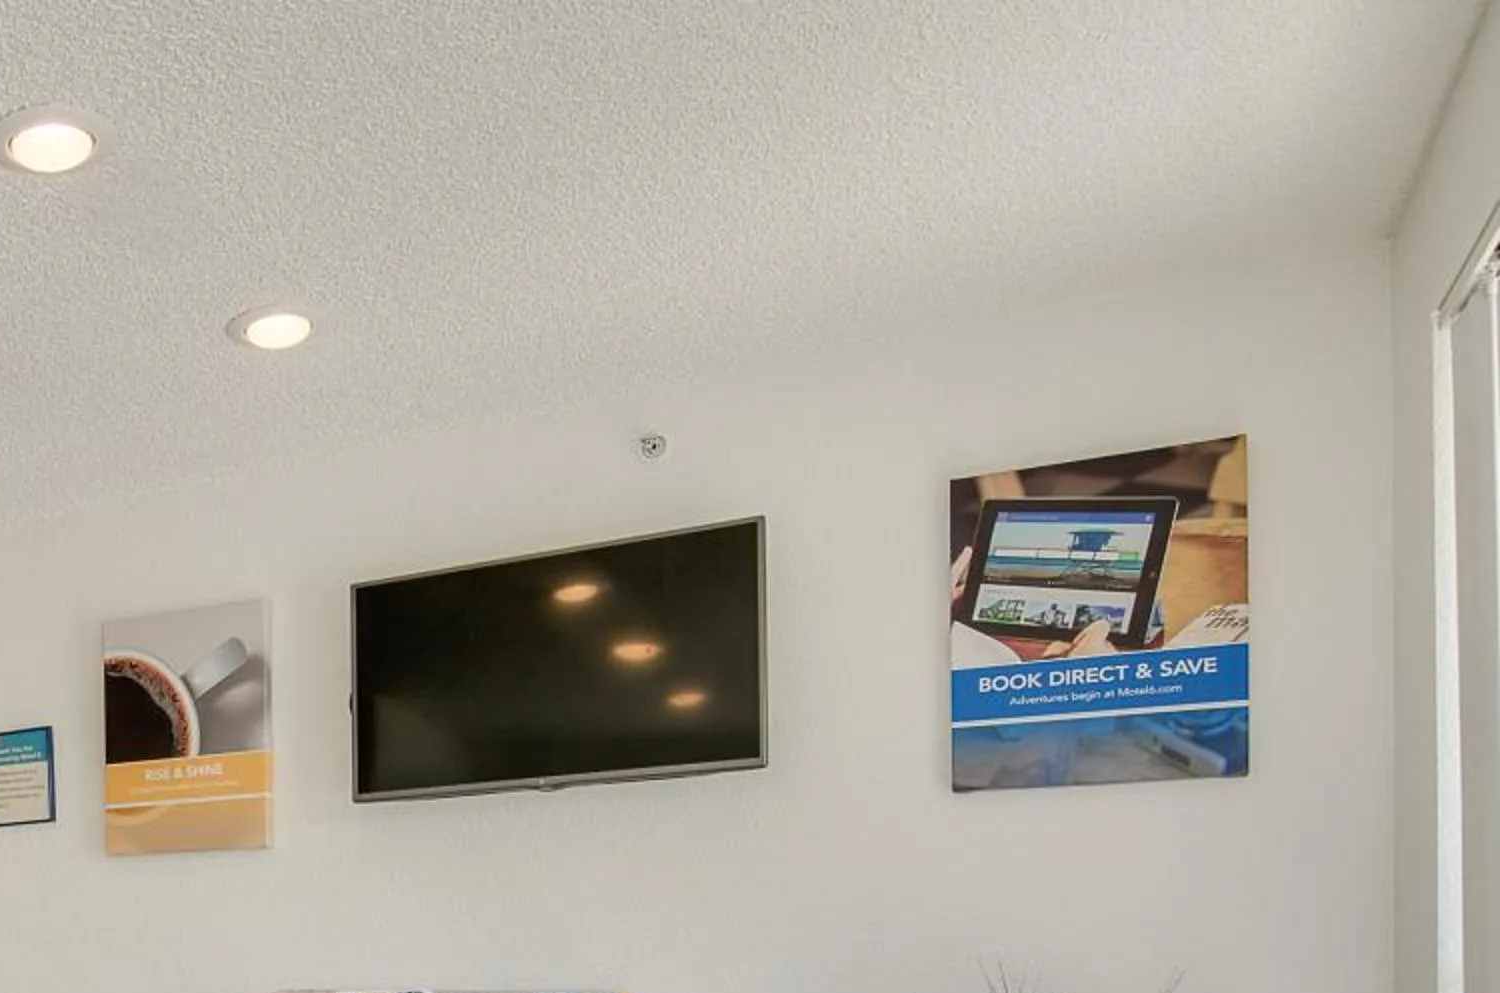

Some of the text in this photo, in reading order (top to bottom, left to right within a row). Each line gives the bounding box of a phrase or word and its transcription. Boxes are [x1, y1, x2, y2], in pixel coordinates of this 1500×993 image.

[978, 656, 1218, 694] BOOK DIRECT & SAVE
[1009, 693, 1069, 706] Adventures
[1071, 688, 1102, 704] begin
